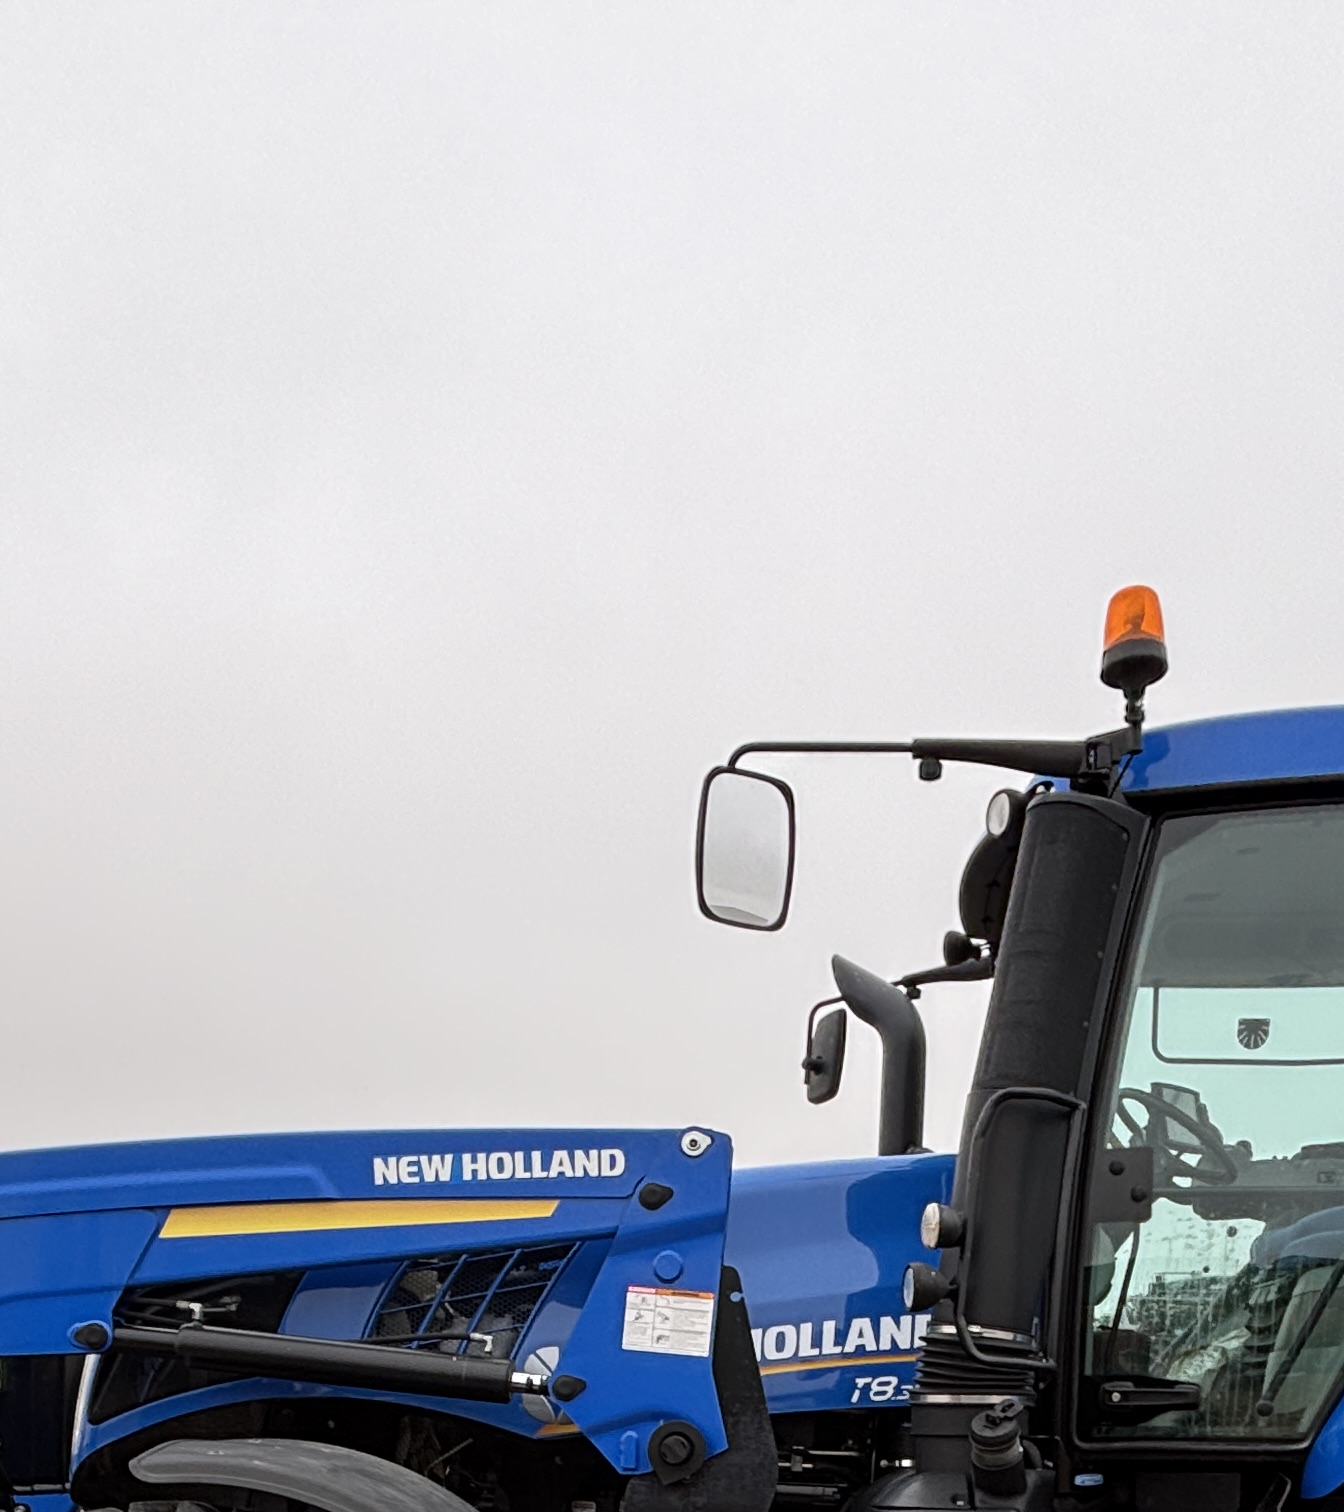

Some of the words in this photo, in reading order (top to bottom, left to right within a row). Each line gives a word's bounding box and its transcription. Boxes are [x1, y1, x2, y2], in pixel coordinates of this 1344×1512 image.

[373, 1154, 453, 1185] NEW
[462, 1149, 625, 1180] HOLLAND
[851, 1376, 920, 1403] T8.3
